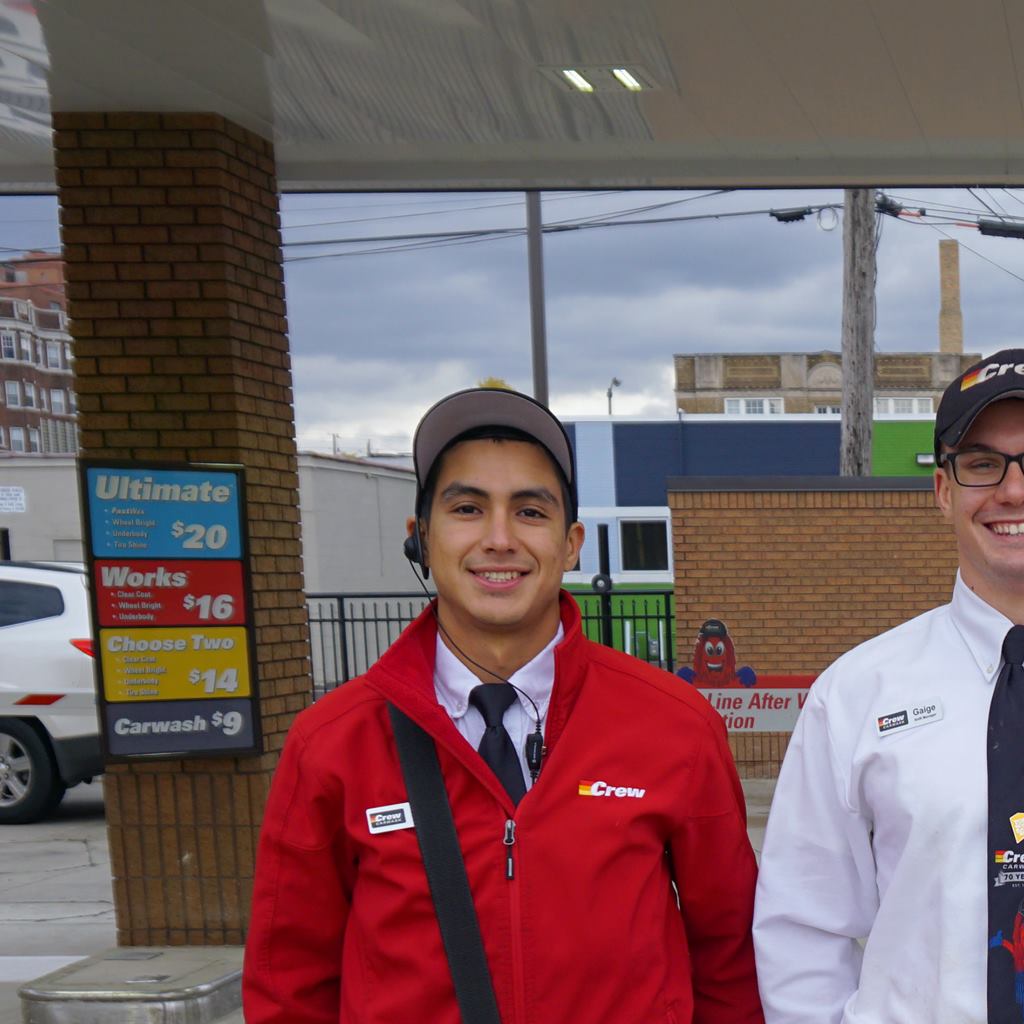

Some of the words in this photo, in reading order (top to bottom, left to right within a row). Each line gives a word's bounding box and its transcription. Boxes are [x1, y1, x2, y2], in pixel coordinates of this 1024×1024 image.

[95, 475, 231, 503] Ultimate
[171, 520, 228, 550] $20
[101, 566, 187, 587] Works
[141, 602, 162, 610] Bright
[183, 593, 234, 619] $16
[118, 613, 154, 621] Underbody
[108, 636, 187, 652] Choose
[191, 634, 235, 650] Two
[189, 667, 239, 693] $14
[708, 692, 743, 710] Line
[747, 692, 792, 710] After
[114, 715, 206, 735] Carwash
[211, 711, 242, 736] $9
[882, 714, 905, 725] Crew
[590, 781, 646, 798] Crew
[375, 812, 402, 823] Crew
